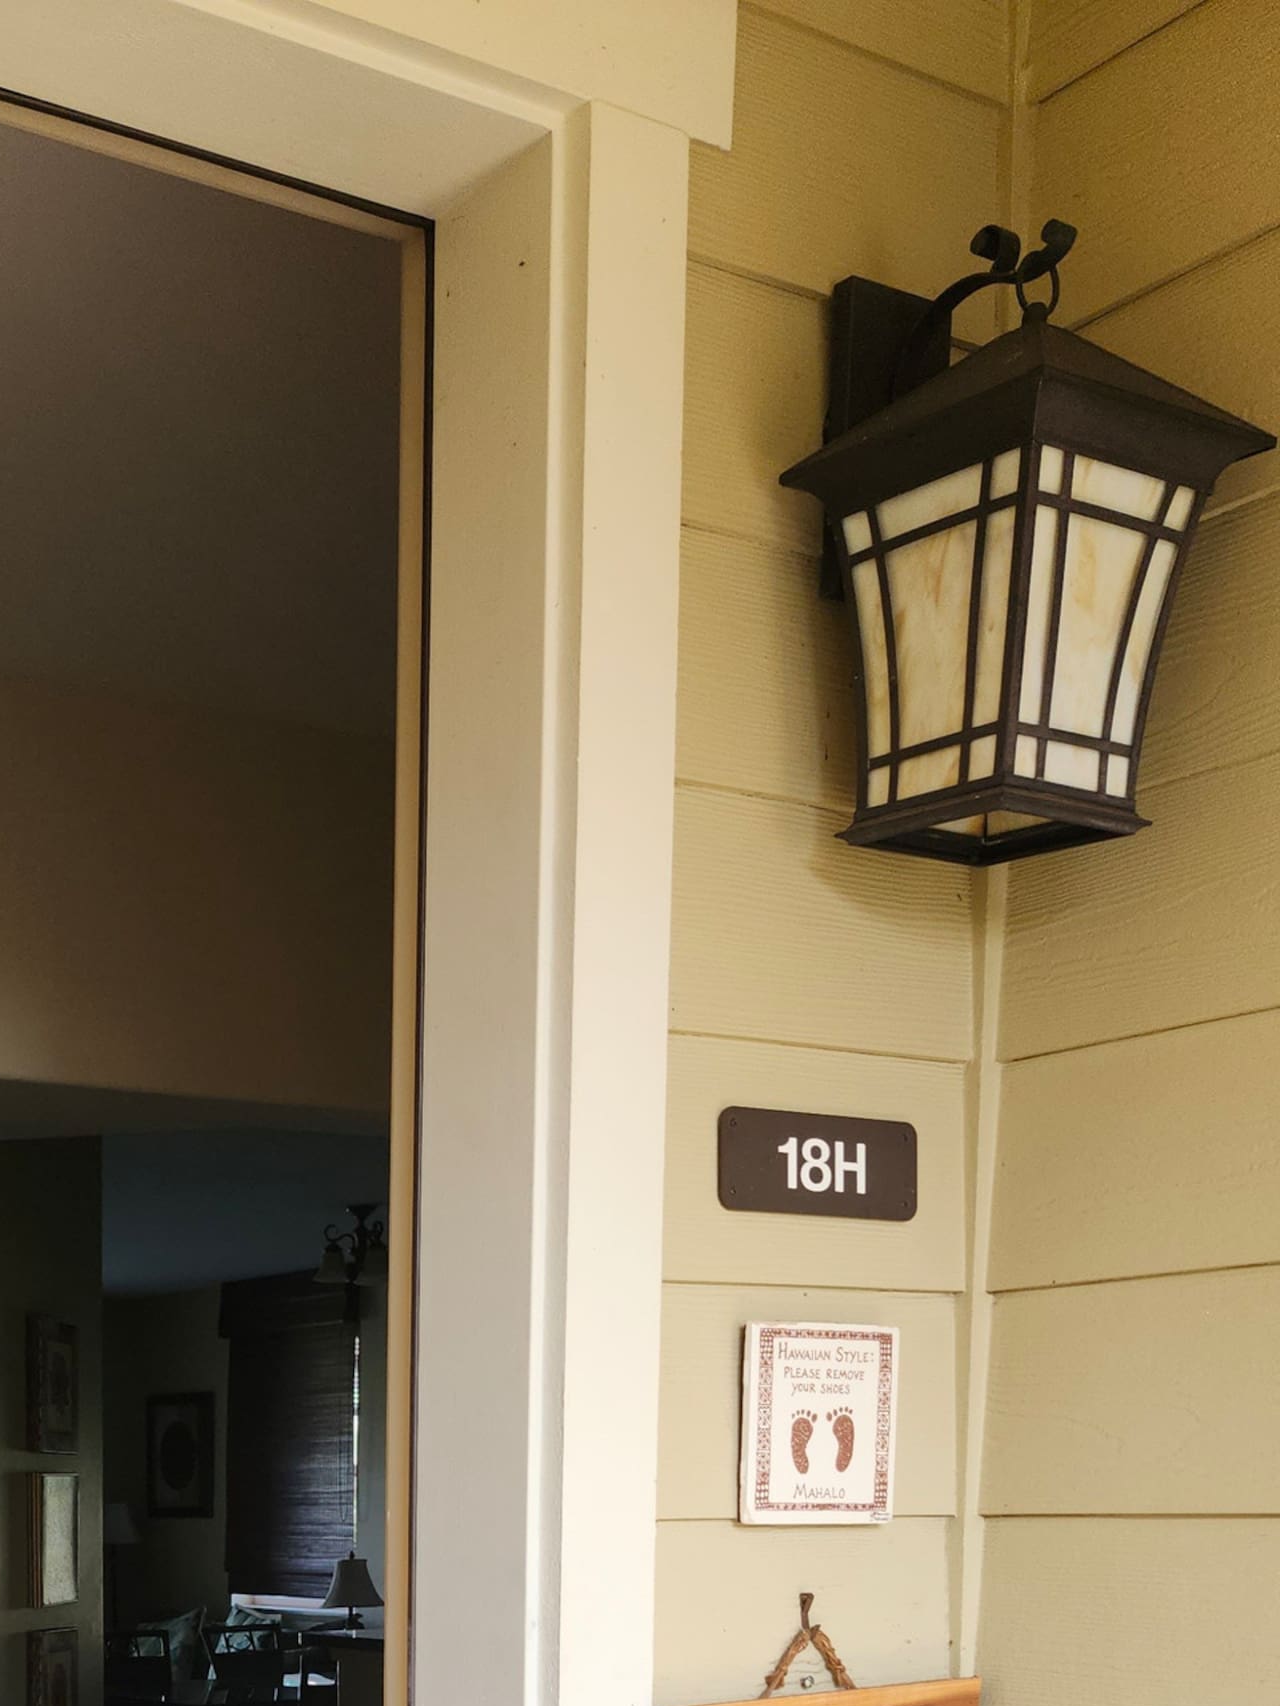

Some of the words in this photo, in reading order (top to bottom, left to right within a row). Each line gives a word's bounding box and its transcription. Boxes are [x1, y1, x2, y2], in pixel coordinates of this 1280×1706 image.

[777, 1136, 867, 1195] 18H
[783, 1366, 821, 1380] PLEASE
[825, 1368, 865, 1381] REMOVE
[791, 1382, 817, 1396] YOUR
[820, 1383, 851, 1395] SHOES
[792, 1483, 846, 1500] MAHALO
